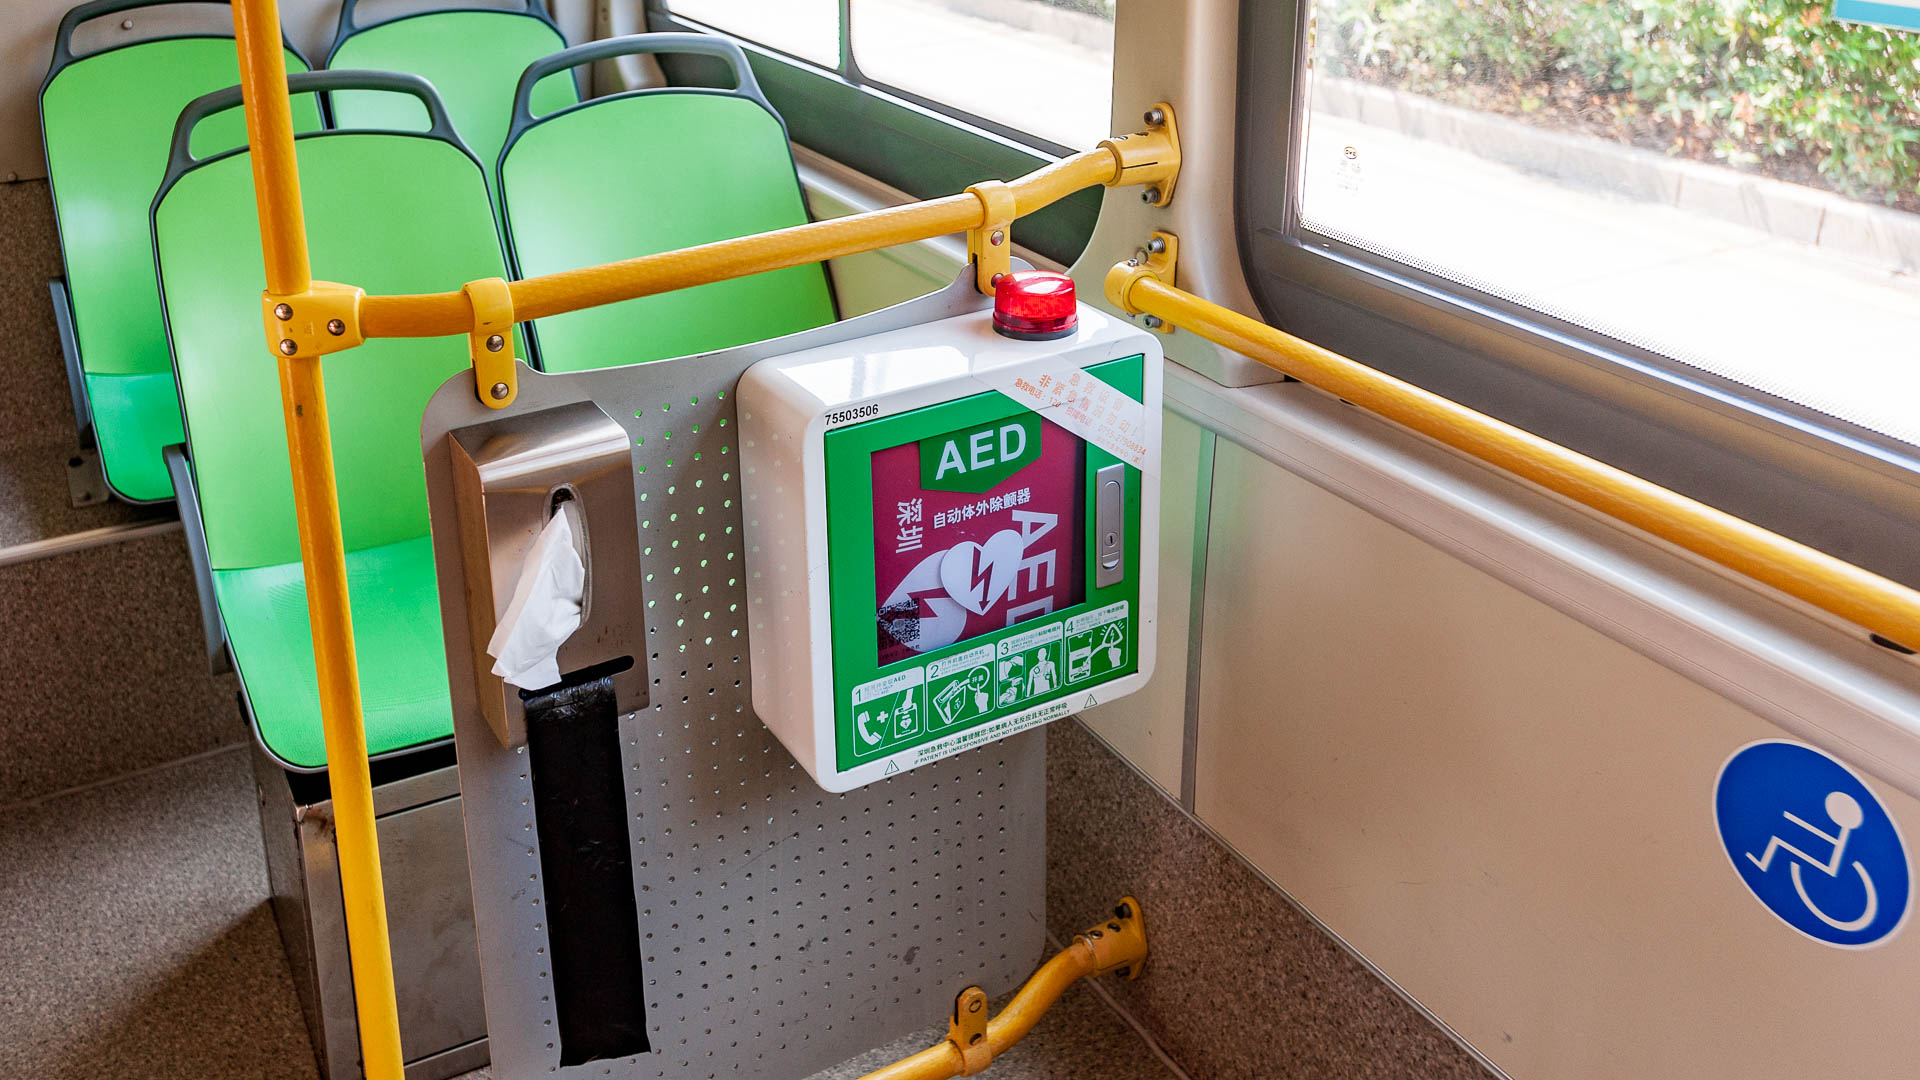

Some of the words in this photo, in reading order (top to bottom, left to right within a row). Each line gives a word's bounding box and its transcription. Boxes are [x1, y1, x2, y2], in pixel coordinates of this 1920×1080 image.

[825, 404, 879, 426] 75503506
[935, 423, 1027, 481] AED
[933, 487, 1031, 530] 自动体外除颤器
[895, 498, 923, 554] 深圳
[1066, 621, 1074, 633] 4
[1000, 642, 1009, 656] 3
[930, 664, 939, 679] 2
[855, 688, 862, 702] 1
[920, 751, 942, 763] PATIENT
[948, 737, 989, 753] UNRESPONSIVE
[1013, 719, 1043, 731] BREATHING
[1043, 710, 1071, 721] NORMALLY
